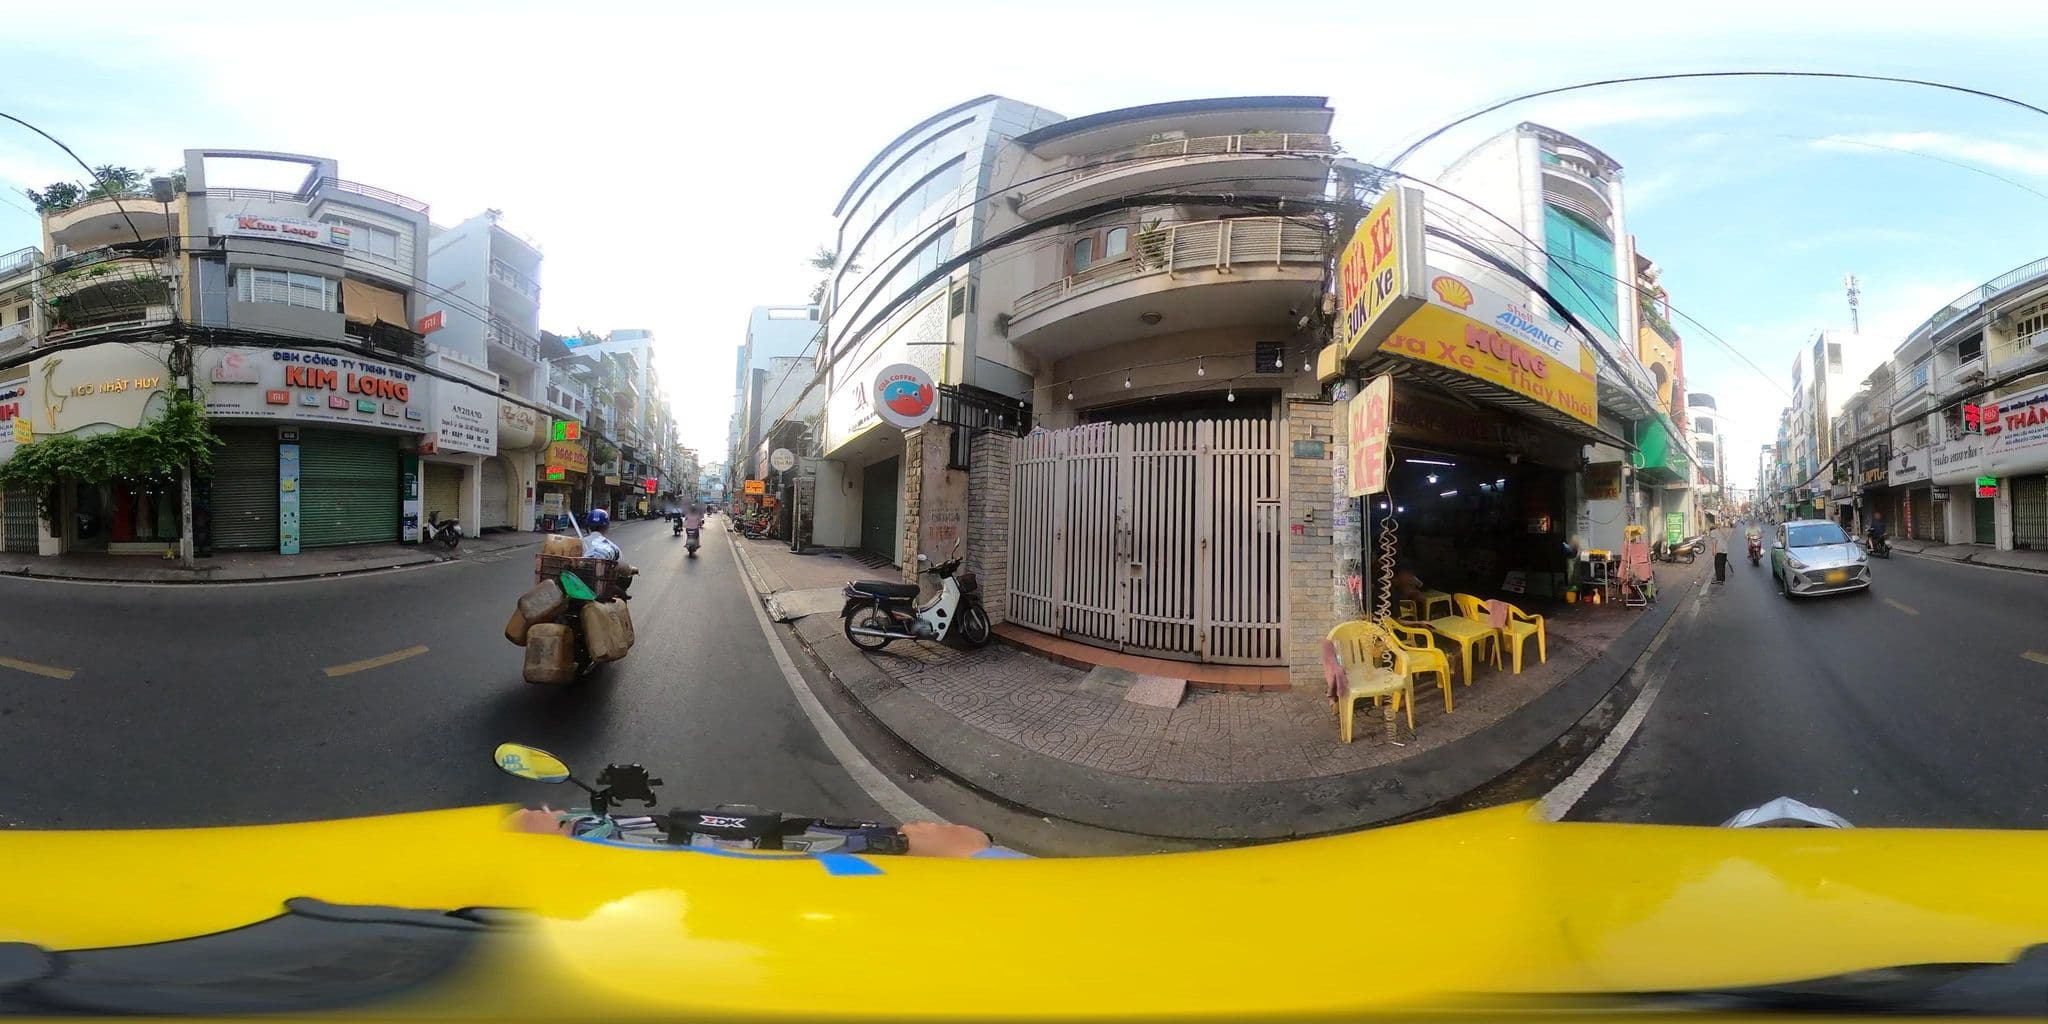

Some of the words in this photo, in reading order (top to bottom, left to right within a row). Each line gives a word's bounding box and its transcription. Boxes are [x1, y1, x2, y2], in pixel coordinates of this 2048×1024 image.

[1370, 207, 1393, 273] XE
[1496, 311, 1564, 352] ADVANCE
[1507, 303, 1534, 323] Shell
[303, 353, 338, 367] CÔNG
[341, 359, 355, 370] TY
[359, 362, 386, 376] TNHH
[1465, 322, 1549, 378] HÙNG
[99, 376, 129, 394] NHẬT
[134, 376, 160, 390] HUY
[286, 364, 337, 391] KIM
[347, 373, 408, 402] LONG
[1507, 366, 1554, 404] Thay
